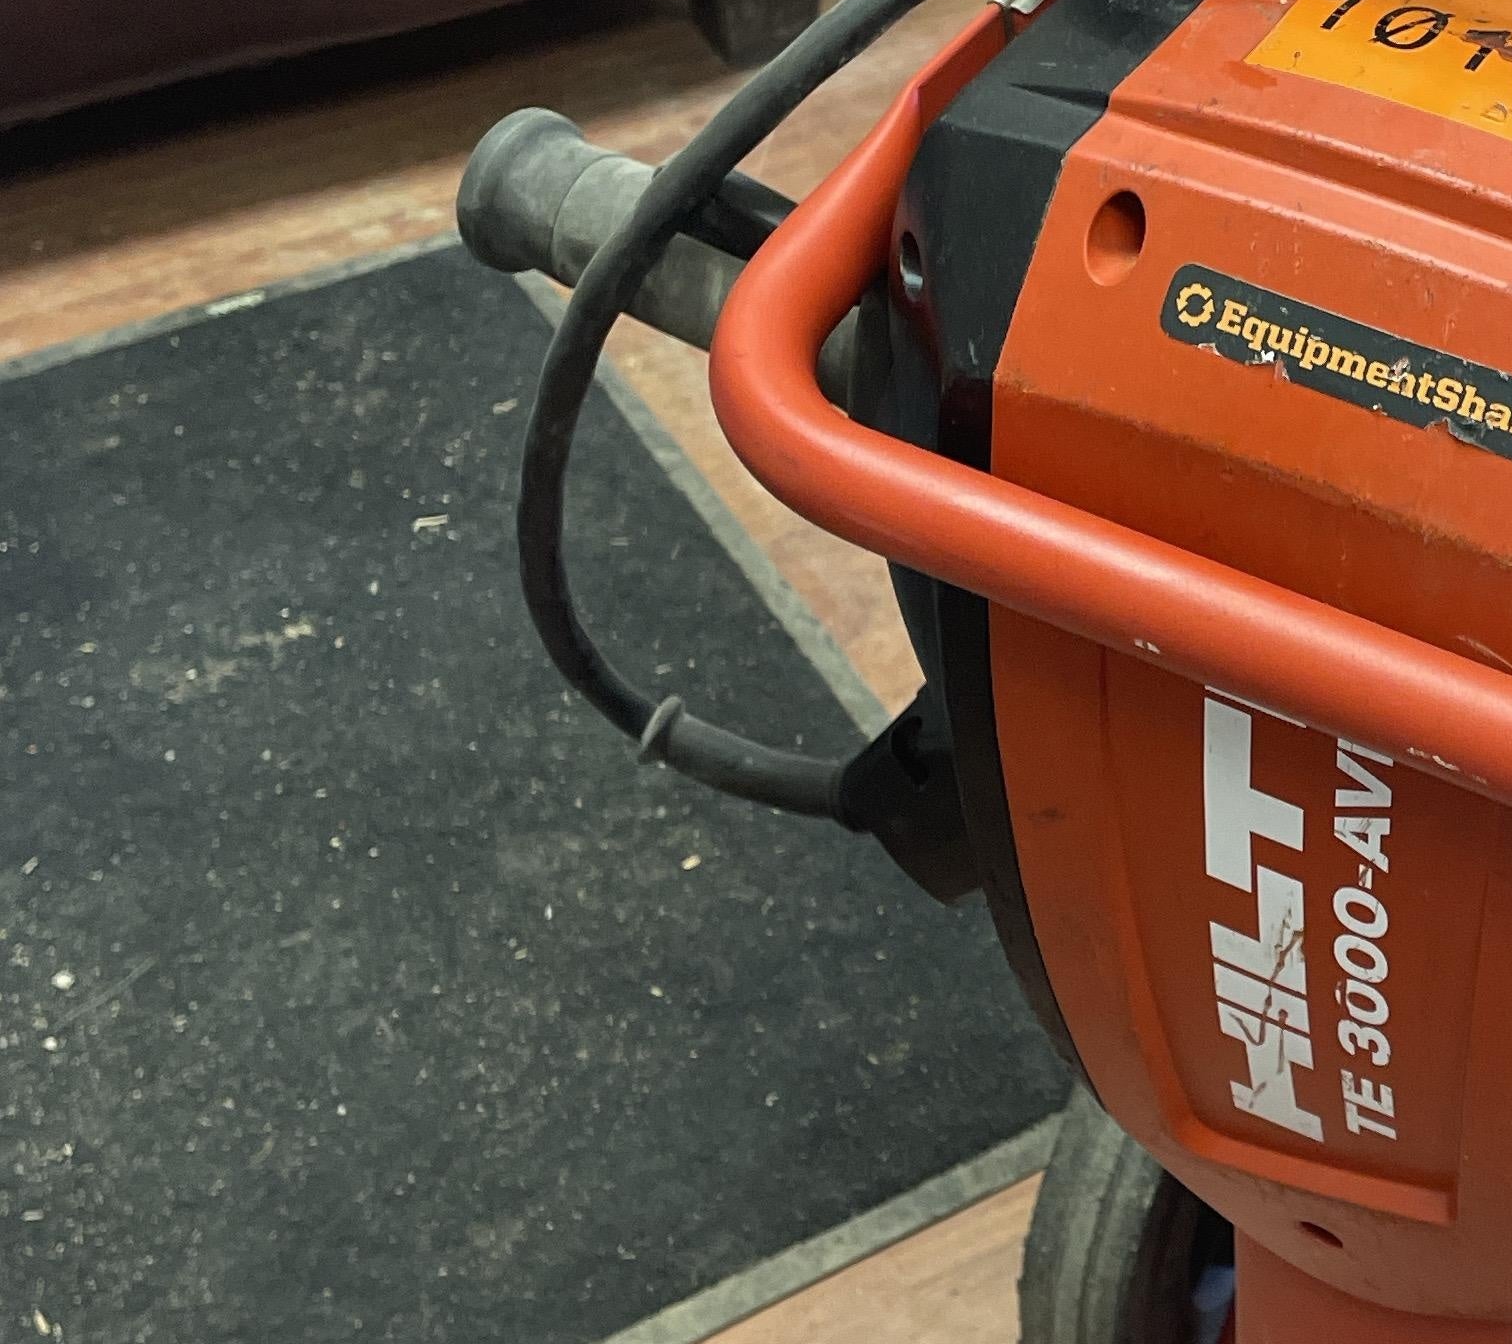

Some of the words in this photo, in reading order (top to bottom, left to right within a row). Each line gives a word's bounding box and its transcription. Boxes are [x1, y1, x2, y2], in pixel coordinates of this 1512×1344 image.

[1203, 685, 1324, 1143] HILT
[1332, 736, 1394, 1067] 3000-AV
[1340, 1068, 1397, 1142] TE
